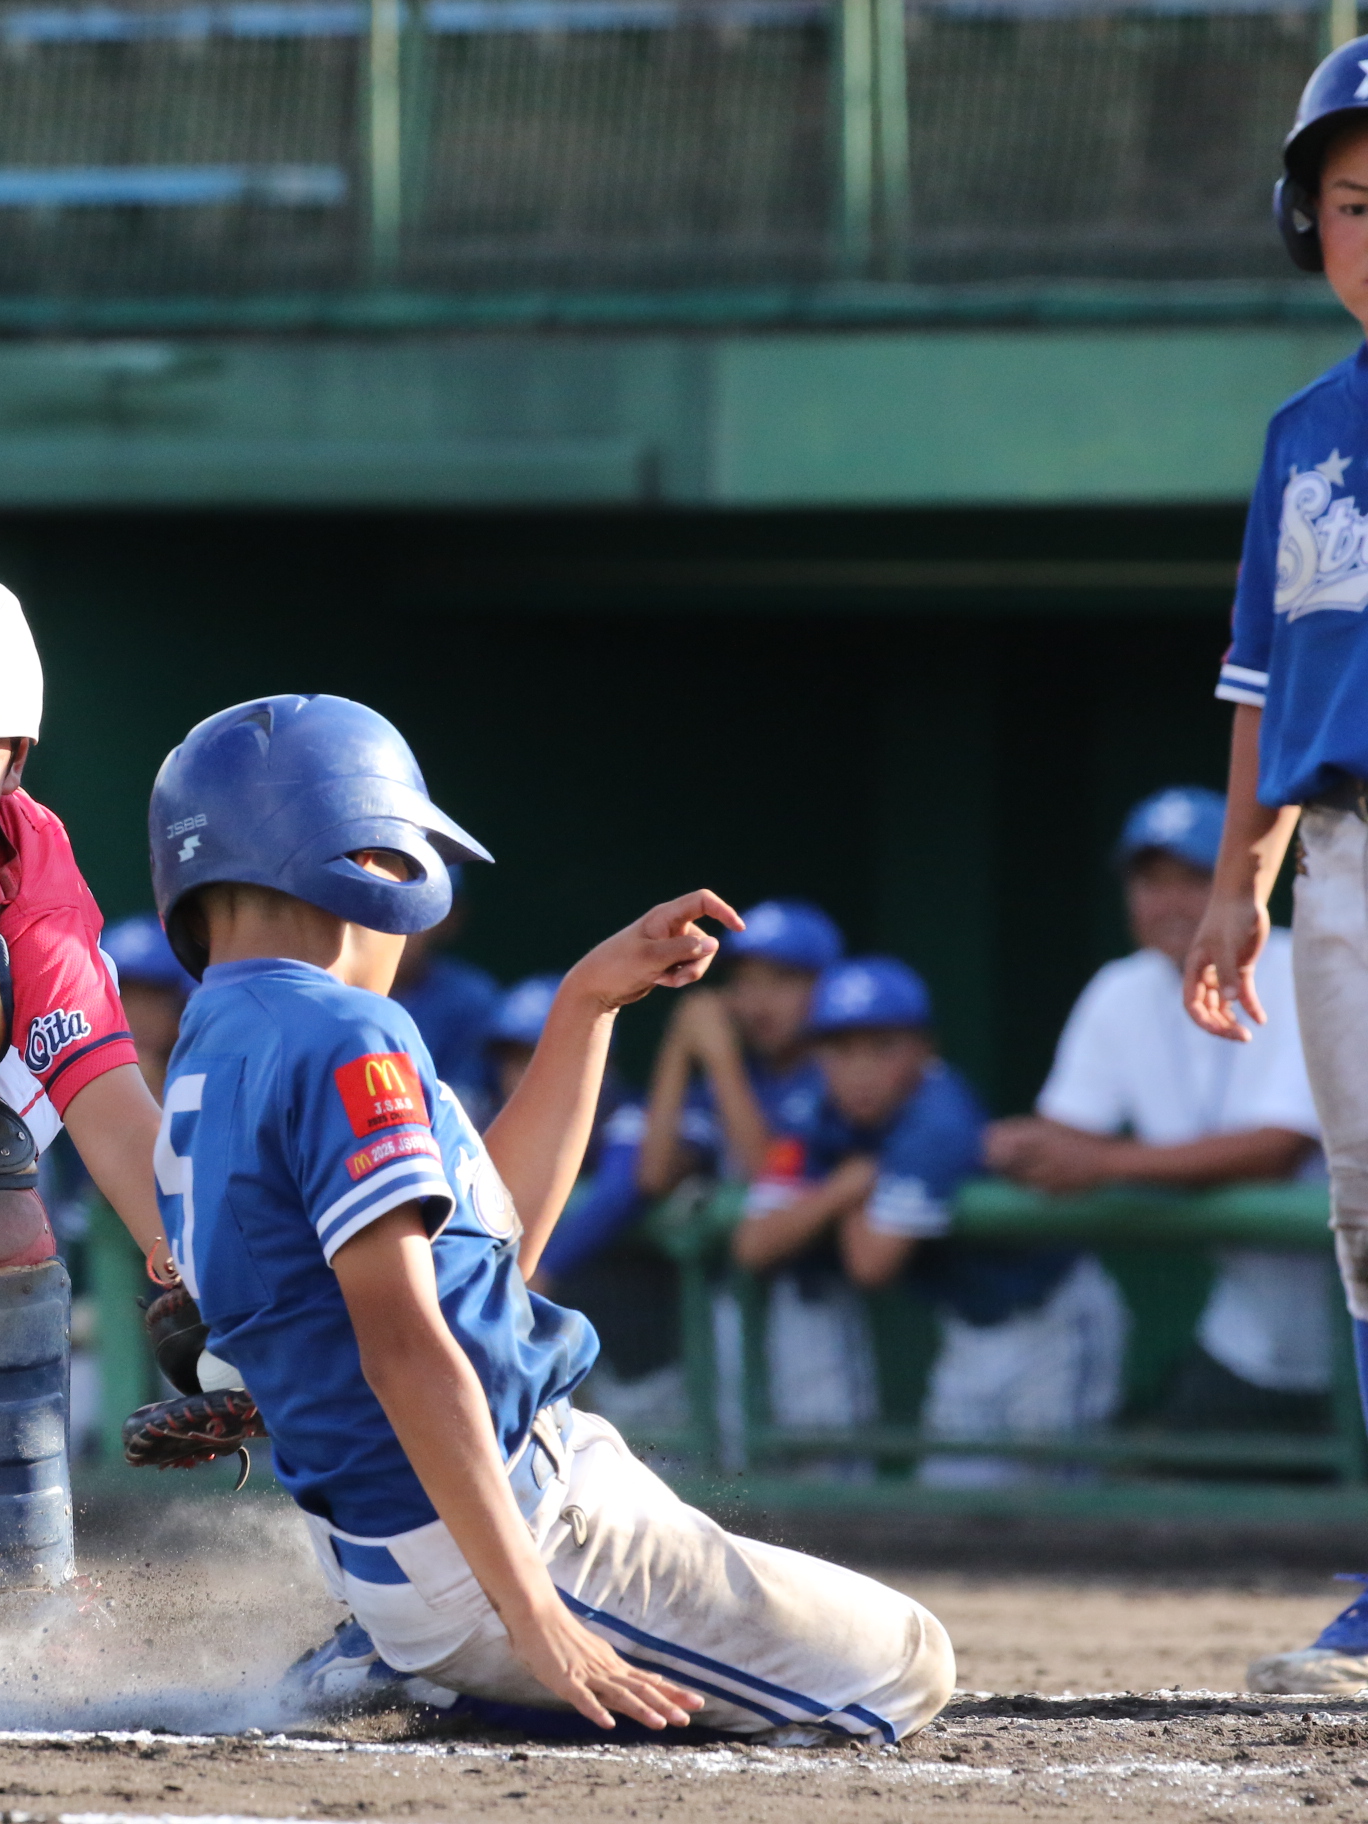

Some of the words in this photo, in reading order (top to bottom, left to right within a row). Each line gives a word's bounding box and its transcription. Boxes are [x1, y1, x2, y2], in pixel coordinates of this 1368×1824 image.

[166, 813, 208, 839] JSBB
[23, 1007, 91, 1075] Oita
[370, 1141, 395, 1162] 2025
